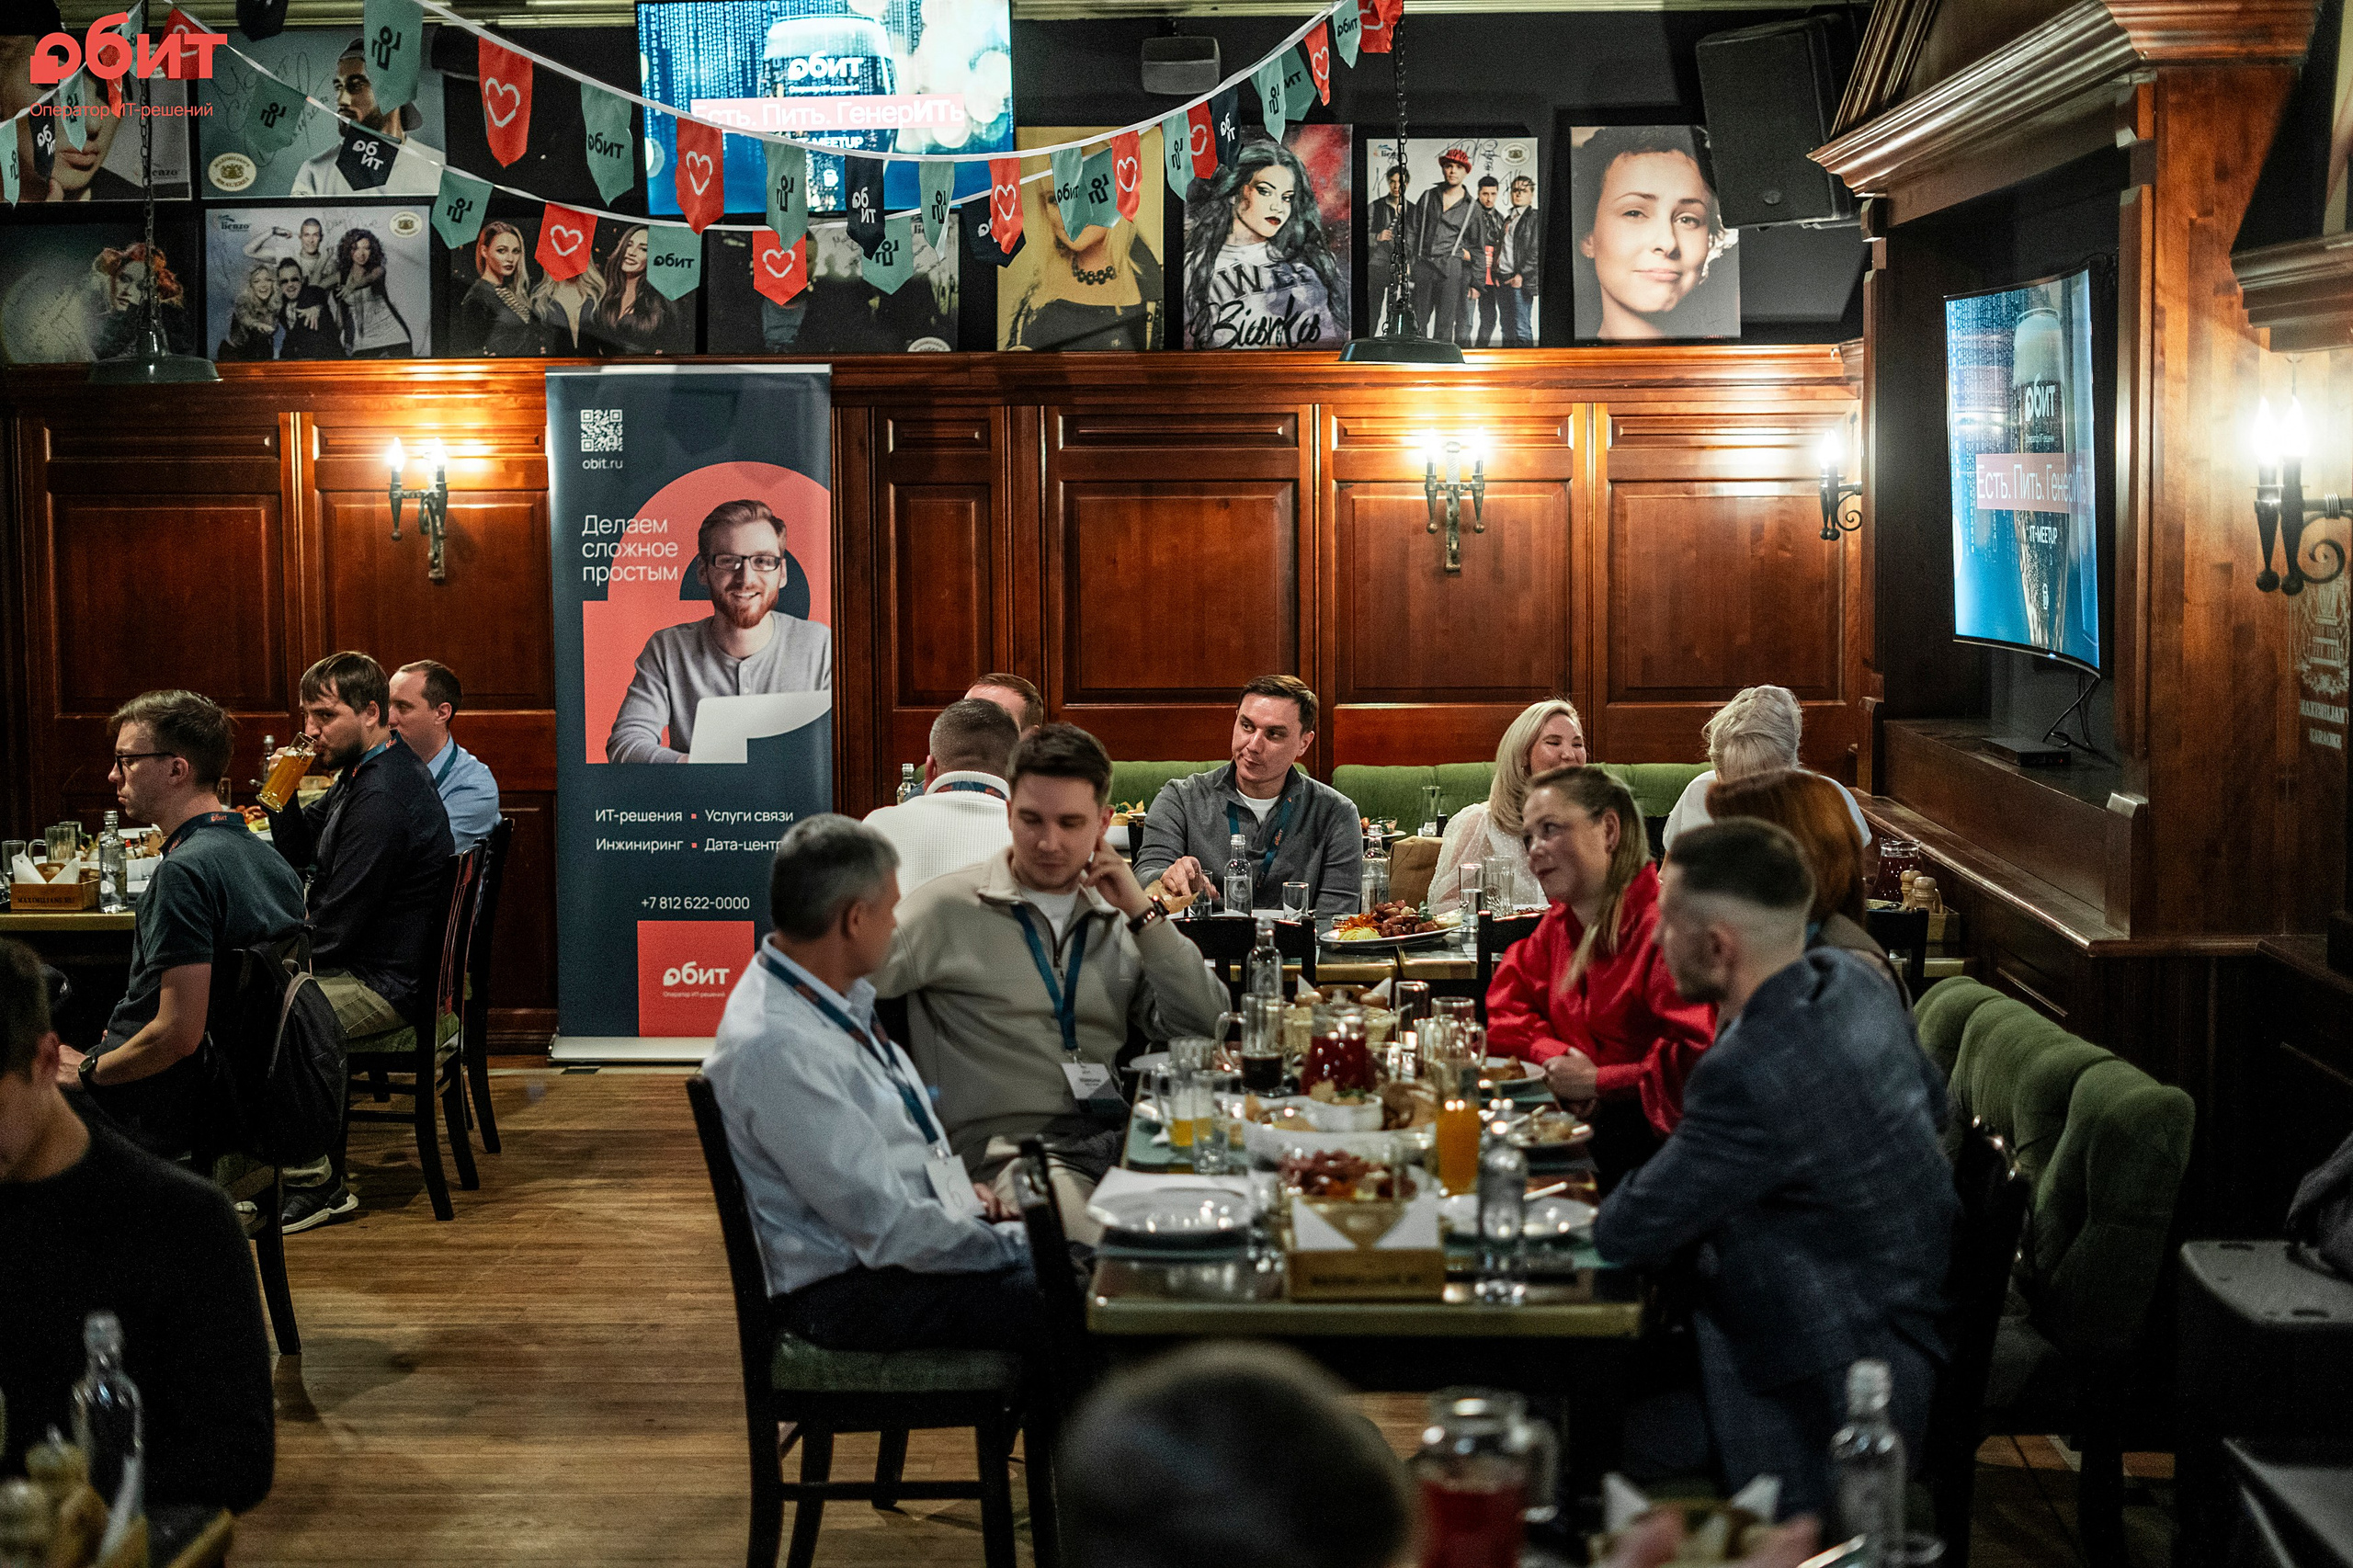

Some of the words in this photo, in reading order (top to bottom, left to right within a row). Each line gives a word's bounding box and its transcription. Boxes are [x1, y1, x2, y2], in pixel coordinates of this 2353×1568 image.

[1284, 71, 1301, 88] ит
[762, 103, 831, 126] Пить.
[588, 132, 625, 159] обит
[654, 253, 695, 268] обит
[582, 458, 623, 470] obit.ru
[1976, 464, 2011, 499] Есть.
[2014, 464, 2045, 500] Пить.
[581, 515, 668, 537] Делаем
[582, 540, 678, 558] сложное
[583, 564, 678, 586] простым
[596, 809, 683, 824] ИТ-решения
[704, 809, 752, 825] Услуги
[754, 812, 794, 822] связи
[596, 838, 684, 853] Инжиниринг
[642, 897, 656, 910] +7
[659, 897, 681, 910] 812
[684, 897, 750, 910] 622-0000
[663, 961, 731, 987] обит
